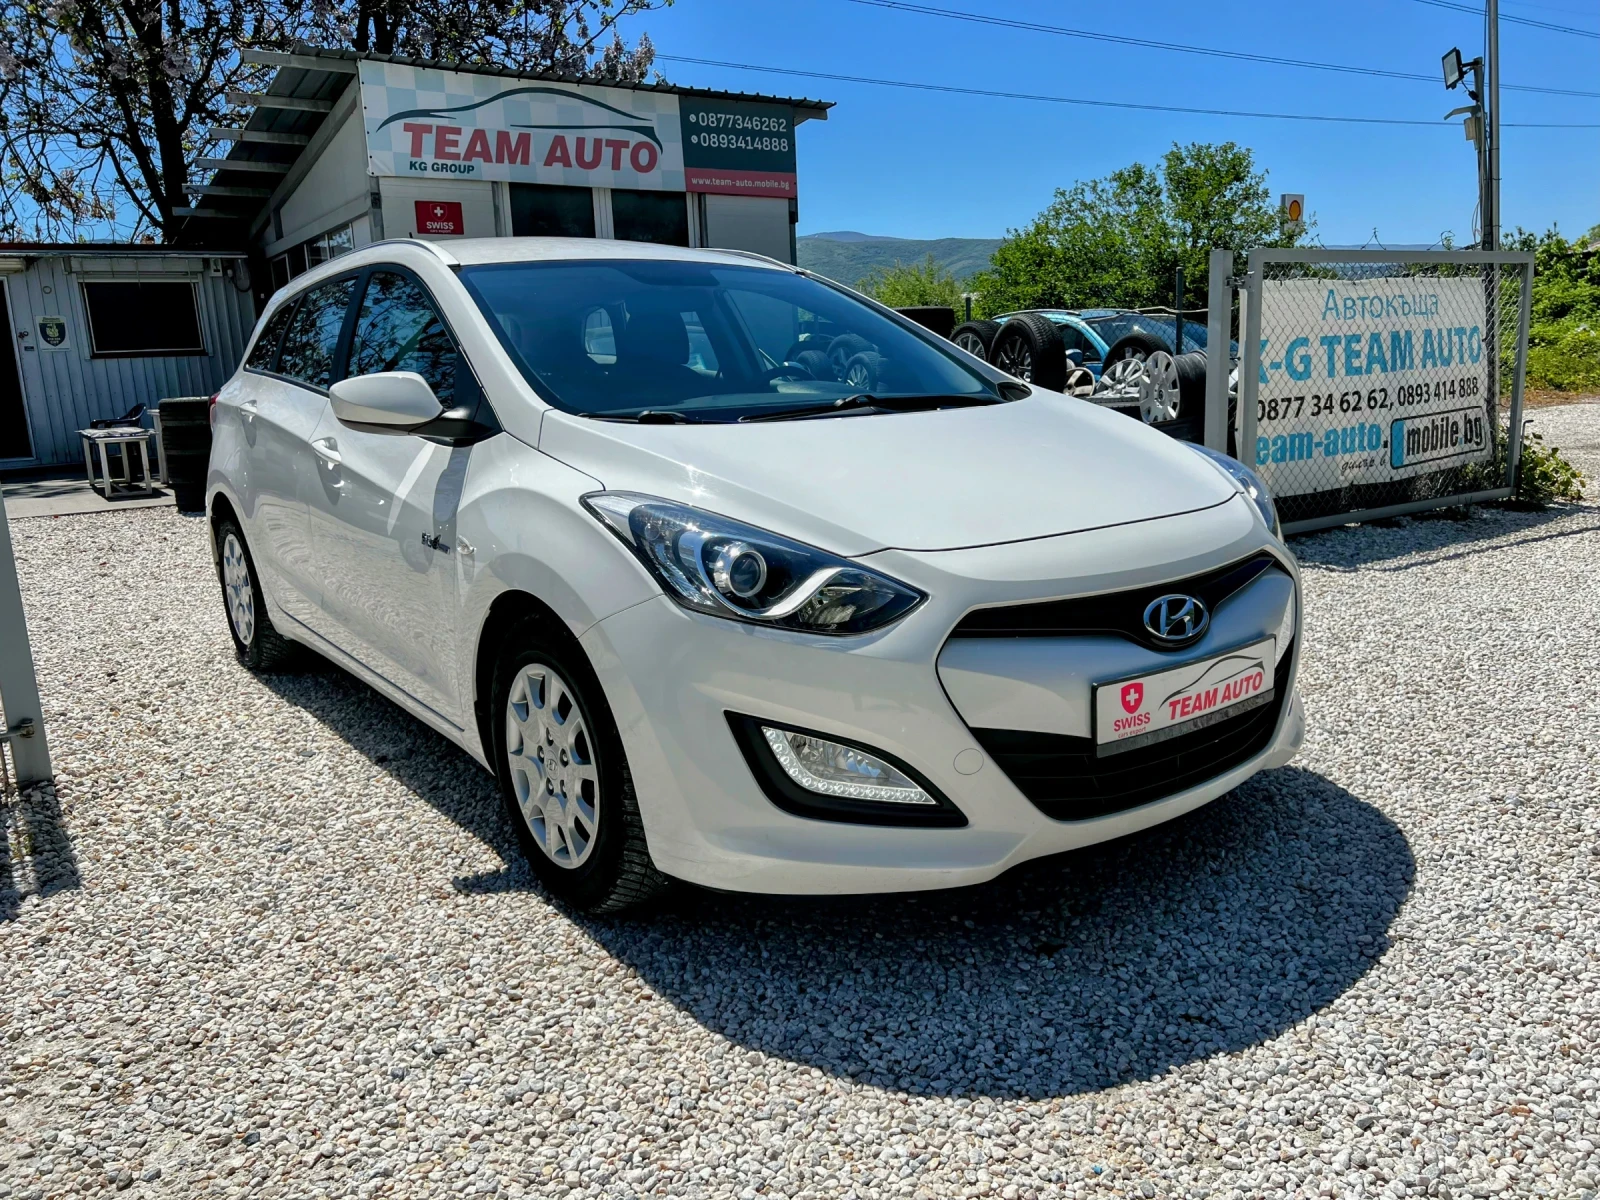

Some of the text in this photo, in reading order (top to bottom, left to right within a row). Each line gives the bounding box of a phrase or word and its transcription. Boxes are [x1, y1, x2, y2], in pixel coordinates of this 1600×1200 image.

[698, 112, 787, 132] 0877346262
[403, 122, 658, 173] TEAM AUTO
[700, 132, 789, 152] 0893414888
[409, 161, 475, 174] KG GROUP
[691, 177, 790, 190] www.team-auto.mobile.bg
[426, 221, 454, 230] SWISS
[1320, 329, 1414, 379] TEAM
[1421, 325, 1481, 369] AUTO
[1257, 376, 1478, 422] 0877 34 62 62, 0893 414 888
[1256, 412, 1483, 466] eam-auto. mobile.bg
[1168, 687, 1219, 721] TEAM
[1220, 671, 1263, 704] AUTO
[1113, 711, 1151, 732] SWISS
[1118, 726, 1147, 739] cars export
